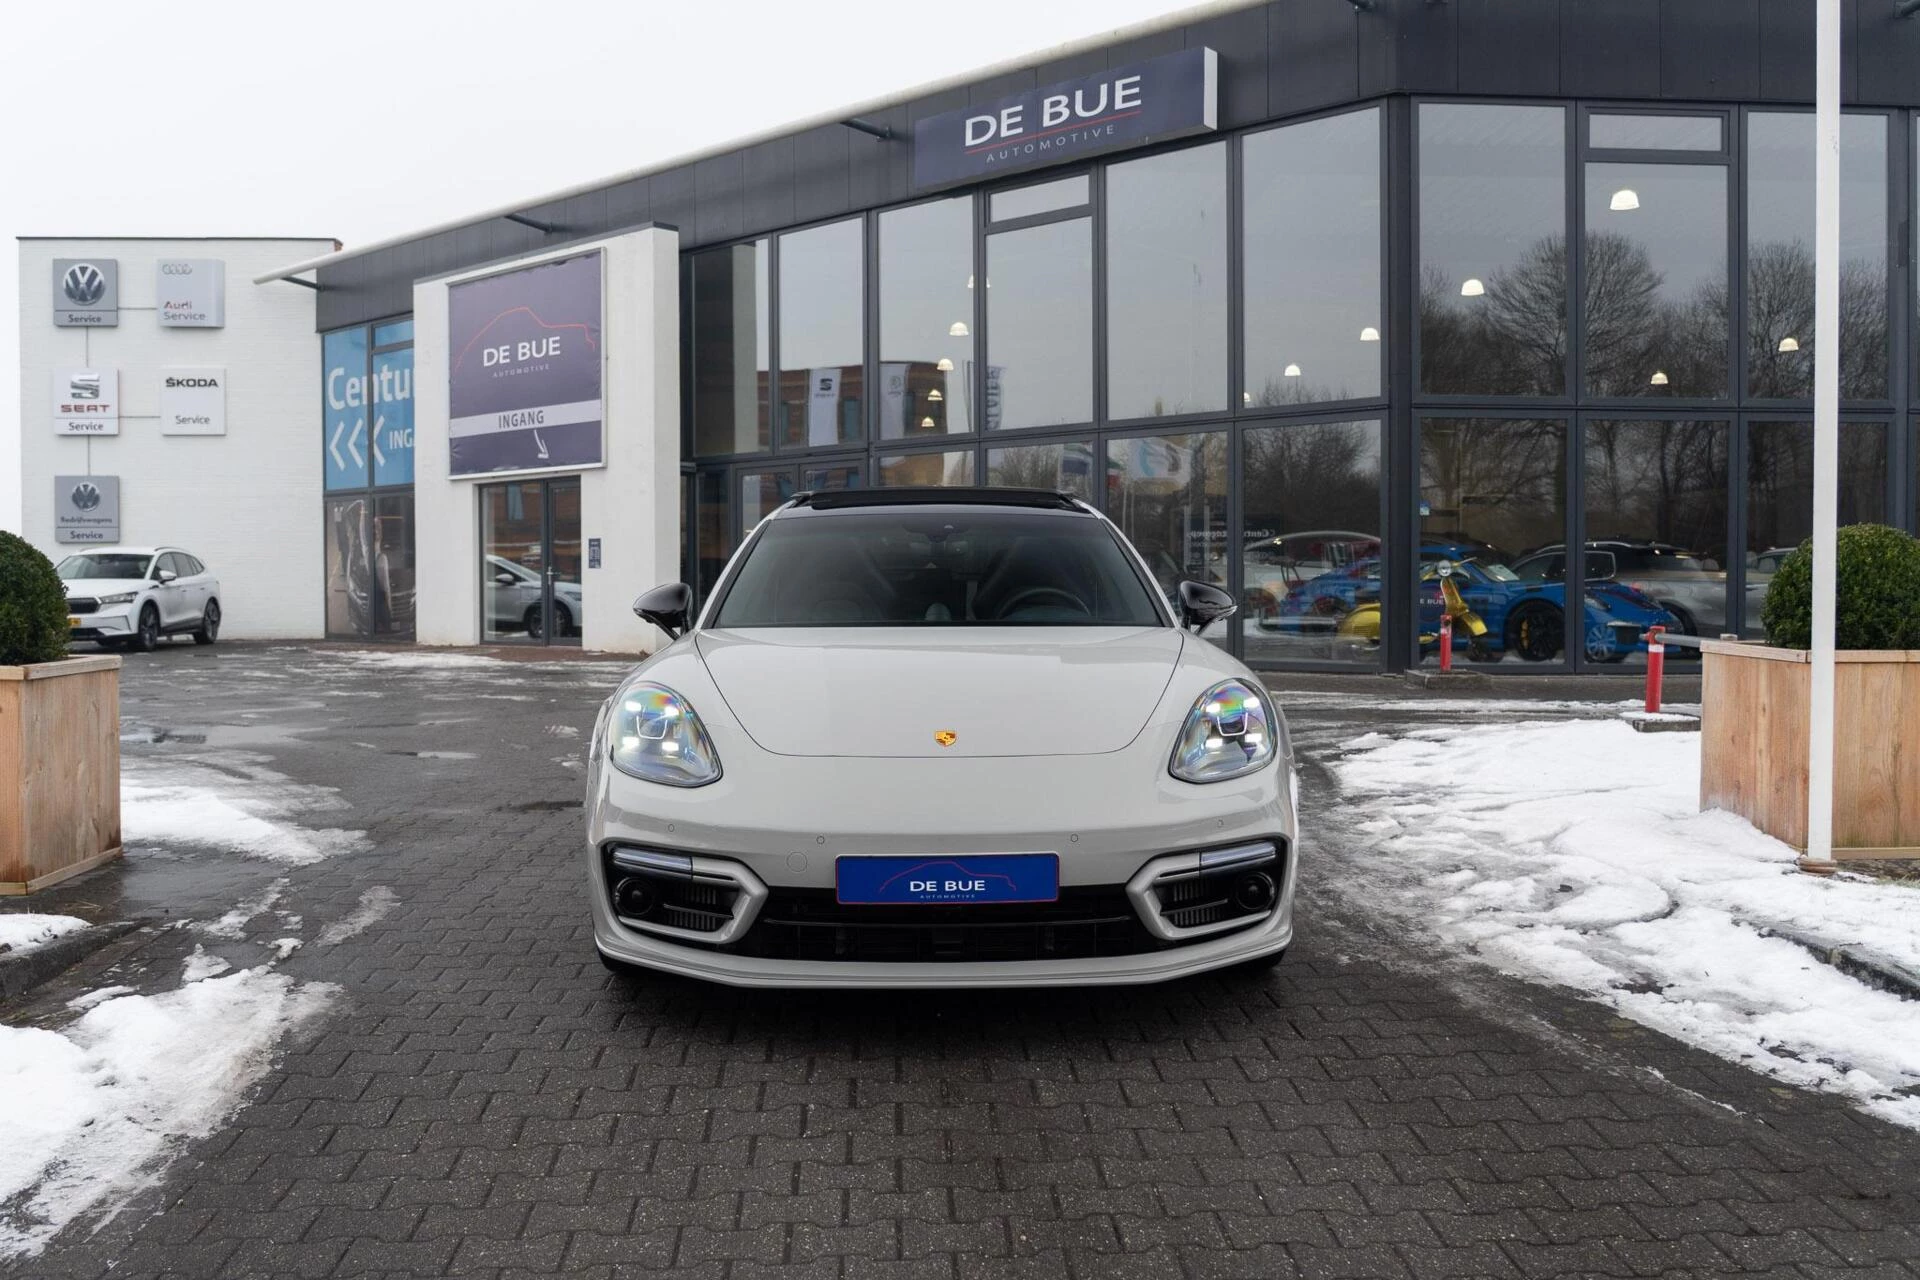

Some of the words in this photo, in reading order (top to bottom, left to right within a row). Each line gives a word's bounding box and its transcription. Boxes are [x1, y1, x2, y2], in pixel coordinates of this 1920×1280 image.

[964, 104, 1024, 148] DE
[1042, 75, 1142, 128] BUE
[986, 124, 1115, 162] AUTOMOTIVE
[163, 300, 193, 310] Audi
[68, 314, 102, 323] Service
[163, 311, 206, 321] Service
[483, 345, 510, 367] DE
[518, 336, 561, 361] BUE
[493, 363, 550, 378] AUTOMOTIVE
[165, 376, 219, 388] ŠKODA
[328, 364, 414, 410] Centu
[60, 404, 111, 413] SEAT
[174, 415, 211, 425] Service
[499, 410, 545, 429] INGANG
[68, 422, 104, 431] Service
[389, 428, 414, 450] ING
[70, 530, 104, 540] Service
[909, 880, 938, 892] DE
[944, 880, 986, 892] BUE
